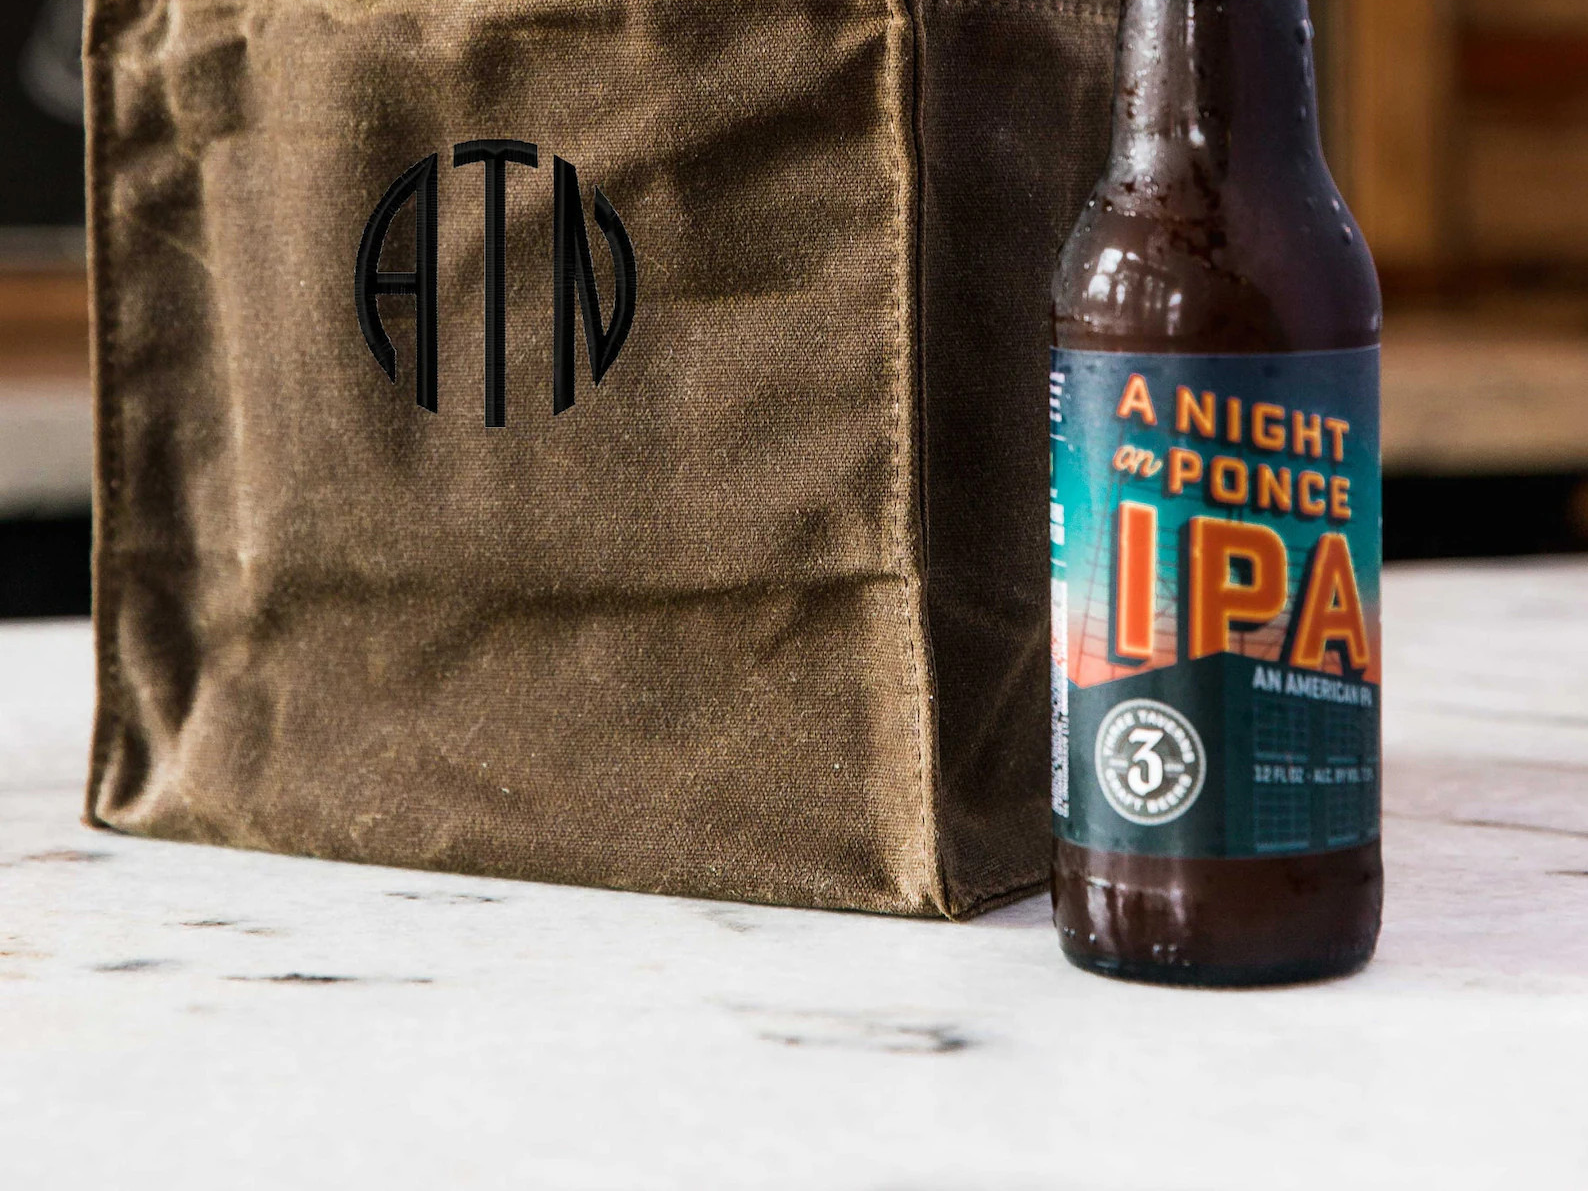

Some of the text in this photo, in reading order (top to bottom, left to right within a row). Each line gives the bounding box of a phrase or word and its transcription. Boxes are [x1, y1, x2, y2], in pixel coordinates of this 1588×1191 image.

[354, 139, 637, 428] ATN
[1116, 373, 1158, 427] A
[1175, 384, 1351, 463] NIGHT
[1112, 444, 1353, 521] on PONCE
[1114, 499, 1371, 669] IPA
[1252, 665, 1283, 693] AN
[1285, 671, 1360, 706] AMERICAN
[1127, 727, 1165, 798] 3
